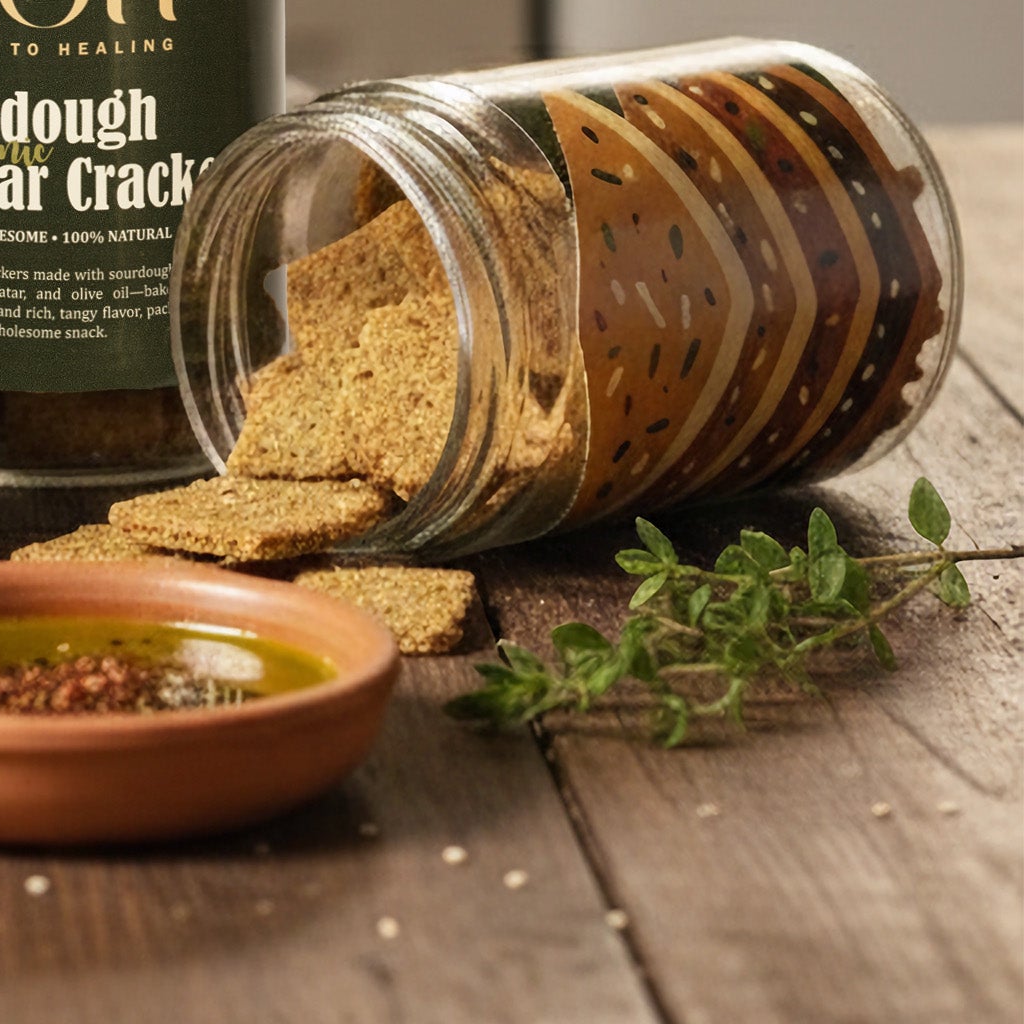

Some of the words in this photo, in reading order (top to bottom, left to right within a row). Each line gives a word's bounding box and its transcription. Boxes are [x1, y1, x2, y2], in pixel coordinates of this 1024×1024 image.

[10, 42, 40, 57] TO
[58, 37, 174, 56] HEALING
[66, 152, 215, 212] Crack
[62, 230, 105, 245] 100%
[107, 226, 173, 243] NATURAL
[33, 268, 71, 281] made
[74, 267, 105, 281] with
[35, 286, 62, 300] and
[71, 286, 104, 301] olive
[112, 282, 169, 300] oil—bak
[25, 305, 55, 321] rich,
[59, 308, 98, 323] tangy
[102, 305, 144, 319] flavor,
[146, 301, 170, 320] pac
[64, 325, 108, 339] snack.
